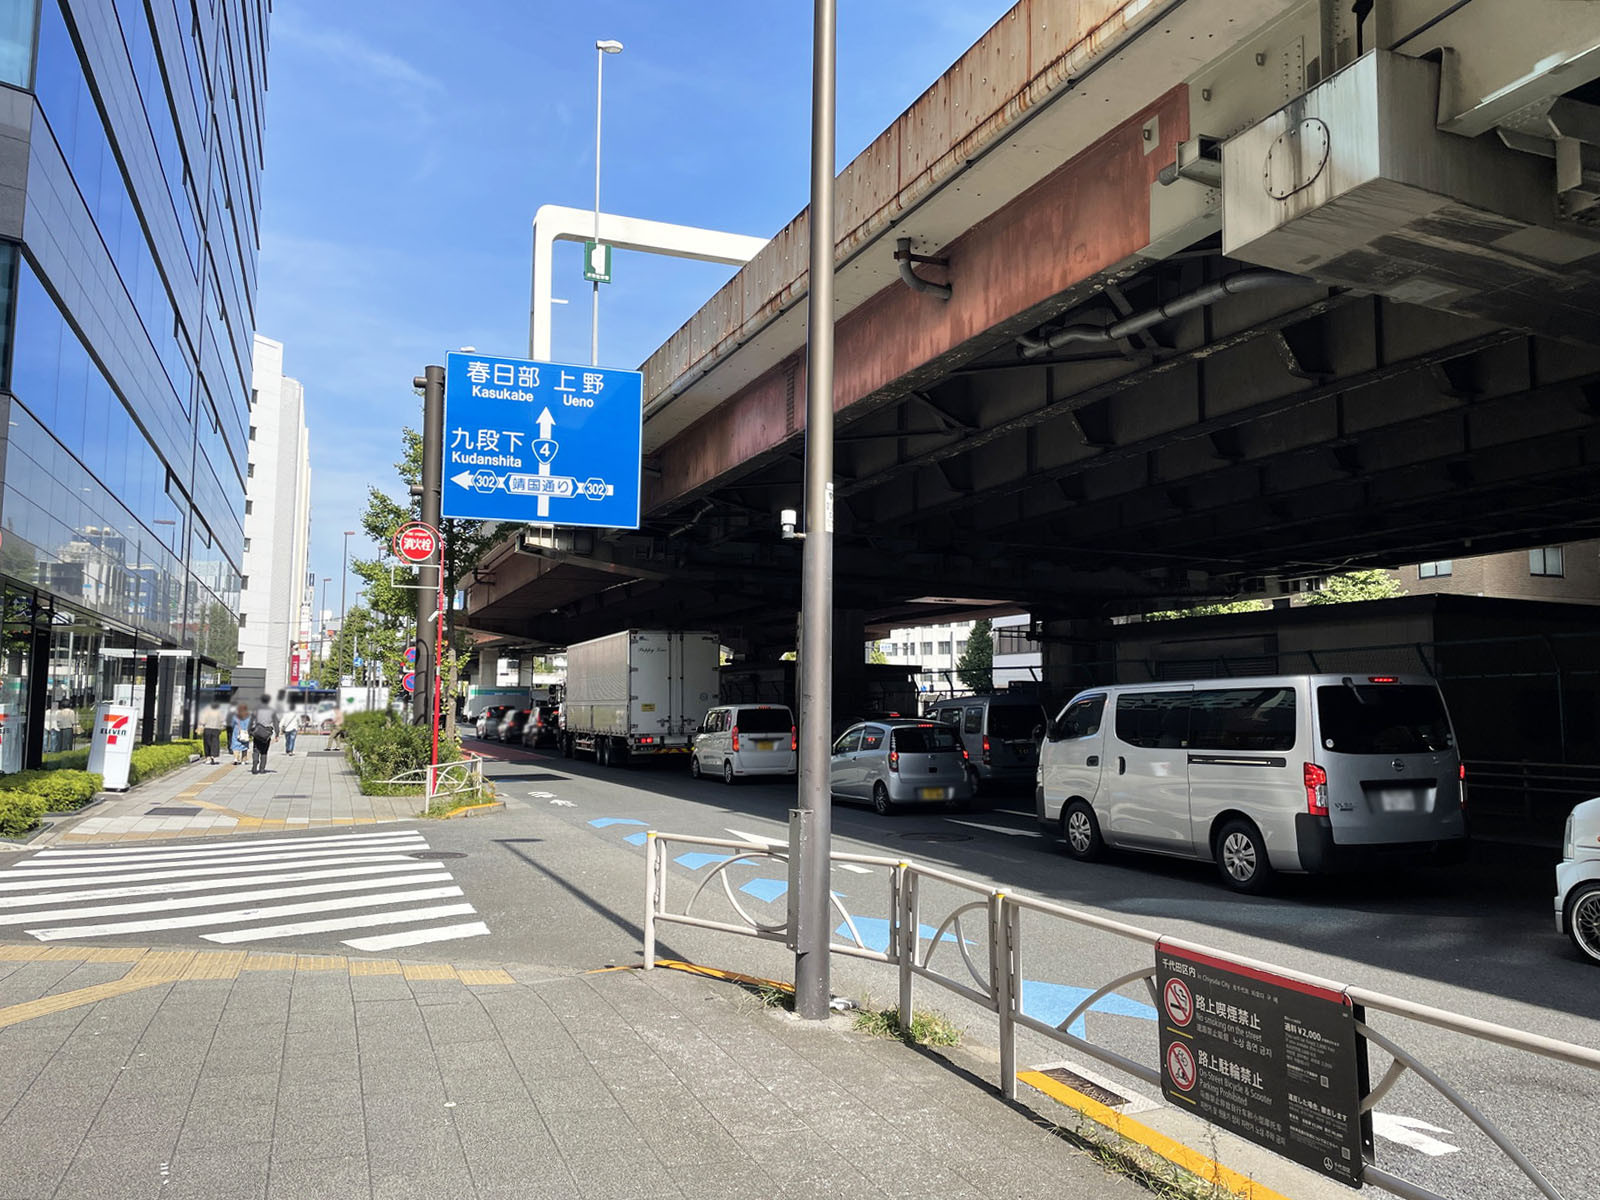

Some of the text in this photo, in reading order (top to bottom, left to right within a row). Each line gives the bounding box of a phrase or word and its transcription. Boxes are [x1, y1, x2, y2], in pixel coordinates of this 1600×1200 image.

[466, 361, 540, 388] 春日部
[554, 370, 604, 395] 上野
[472, 385, 534, 402] Kasukabe
[563, 394, 594, 408] Ueno
[450, 427, 525, 453] 九段下
[539, 443, 551, 457] 4
[451, 451, 522, 468] Kudanshita
[475, 476, 495, 487] 302
[512, 477, 569, 493] 靖国通り
[586, 483, 605, 495] 302
[403, 537, 432, 551] 消火栓
[1162, 958, 1196, 978] 千代田区内
[1195, 994, 1261, 1031] 路上喫煙禁止
[1204, 1016, 1226, 1032] smoking
[1227, 1024, 1234, 1033] on
[1235, 1026, 1244, 1036] the
[1259, 1046, 1272, 1059] 금지
[1198, 1049, 1263, 1091] 路上駐輪禁止
